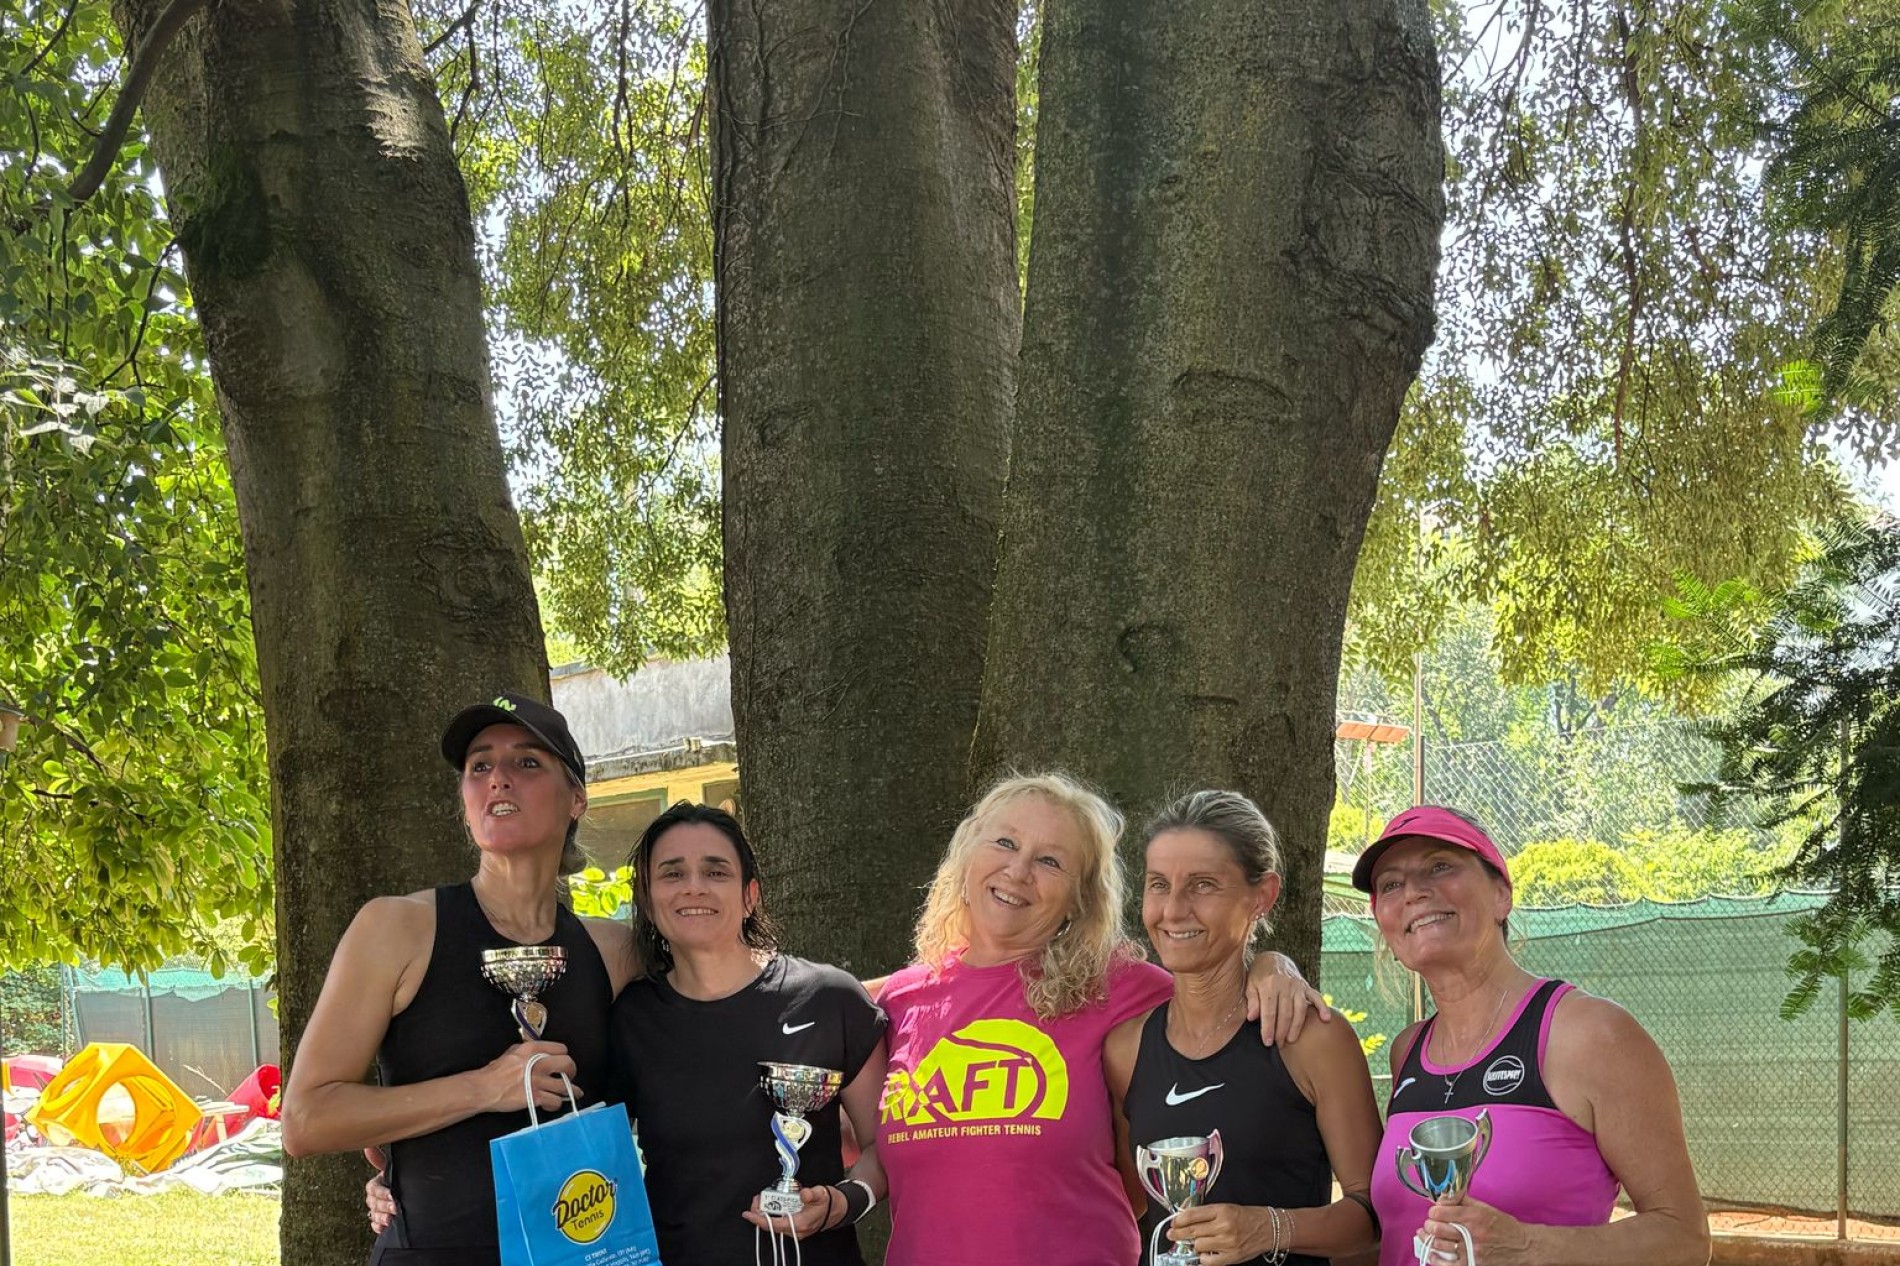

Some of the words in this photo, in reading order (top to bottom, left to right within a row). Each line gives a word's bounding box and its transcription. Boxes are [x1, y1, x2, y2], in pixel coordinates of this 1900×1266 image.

[887, 1131, 911, 1145] REBEL
[912, 1126, 958, 1141] AMATEUR
[960, 1124, 1001, 1136] FIGHTER
[1004, 1123, 1042, 1136] TENNIS
[552, 1181, 617, 1229] Doctor
[571, 1208, 605, 1231] Tennis
